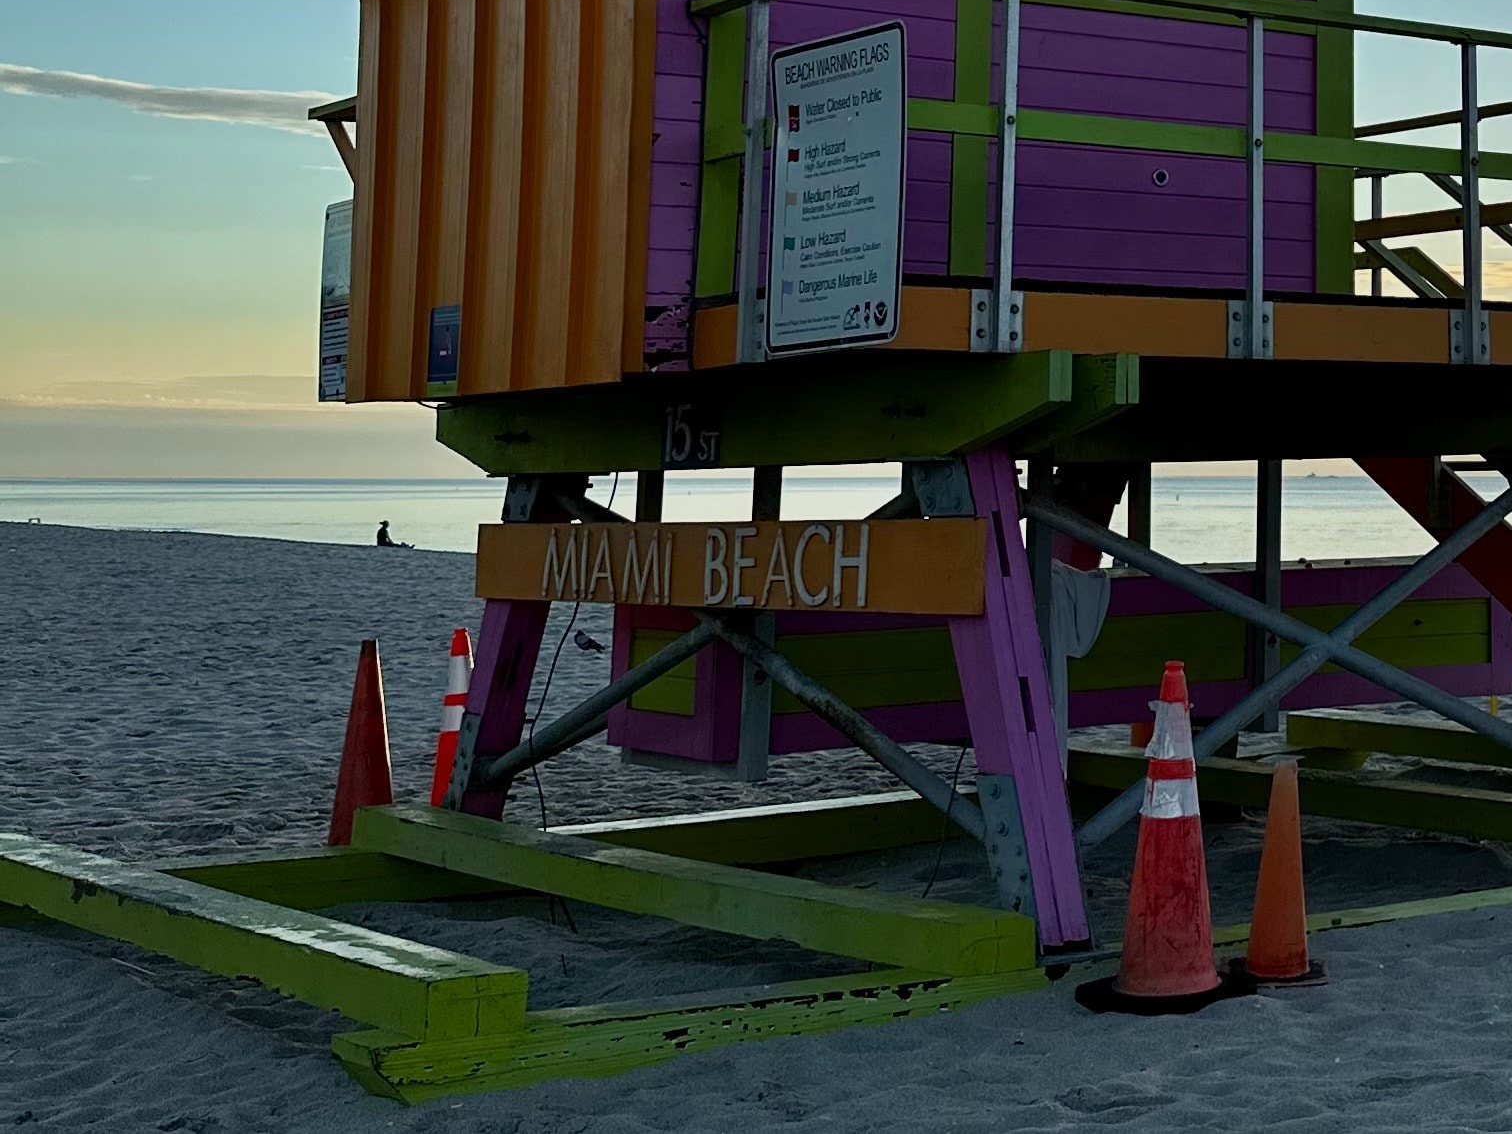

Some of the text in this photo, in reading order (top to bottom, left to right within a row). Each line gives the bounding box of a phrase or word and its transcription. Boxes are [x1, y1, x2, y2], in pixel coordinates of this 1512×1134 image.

[785, 61, 815, 85] BEACH
[816, 51, 858, 77] WARNING
[860, 43, 889, 67] FLAGS
[805, 88, 882, 117] Water Closed to Public
[805, 140, 846, 162] High Hazard
[804, 162, 815, 173] High
[816, 159, 826, 170] Surf
[803, 181, 860, 205] Medium Hazard
[800, 228, 847, 250] Low Hazard
[862, 242, 881, 252] Caution
[799, 268, 878, 296] Dangerous Marine Life
[664, 403, 721, 463] 15 ST
[542, 523, 870, 609] MIAMI BEACH
